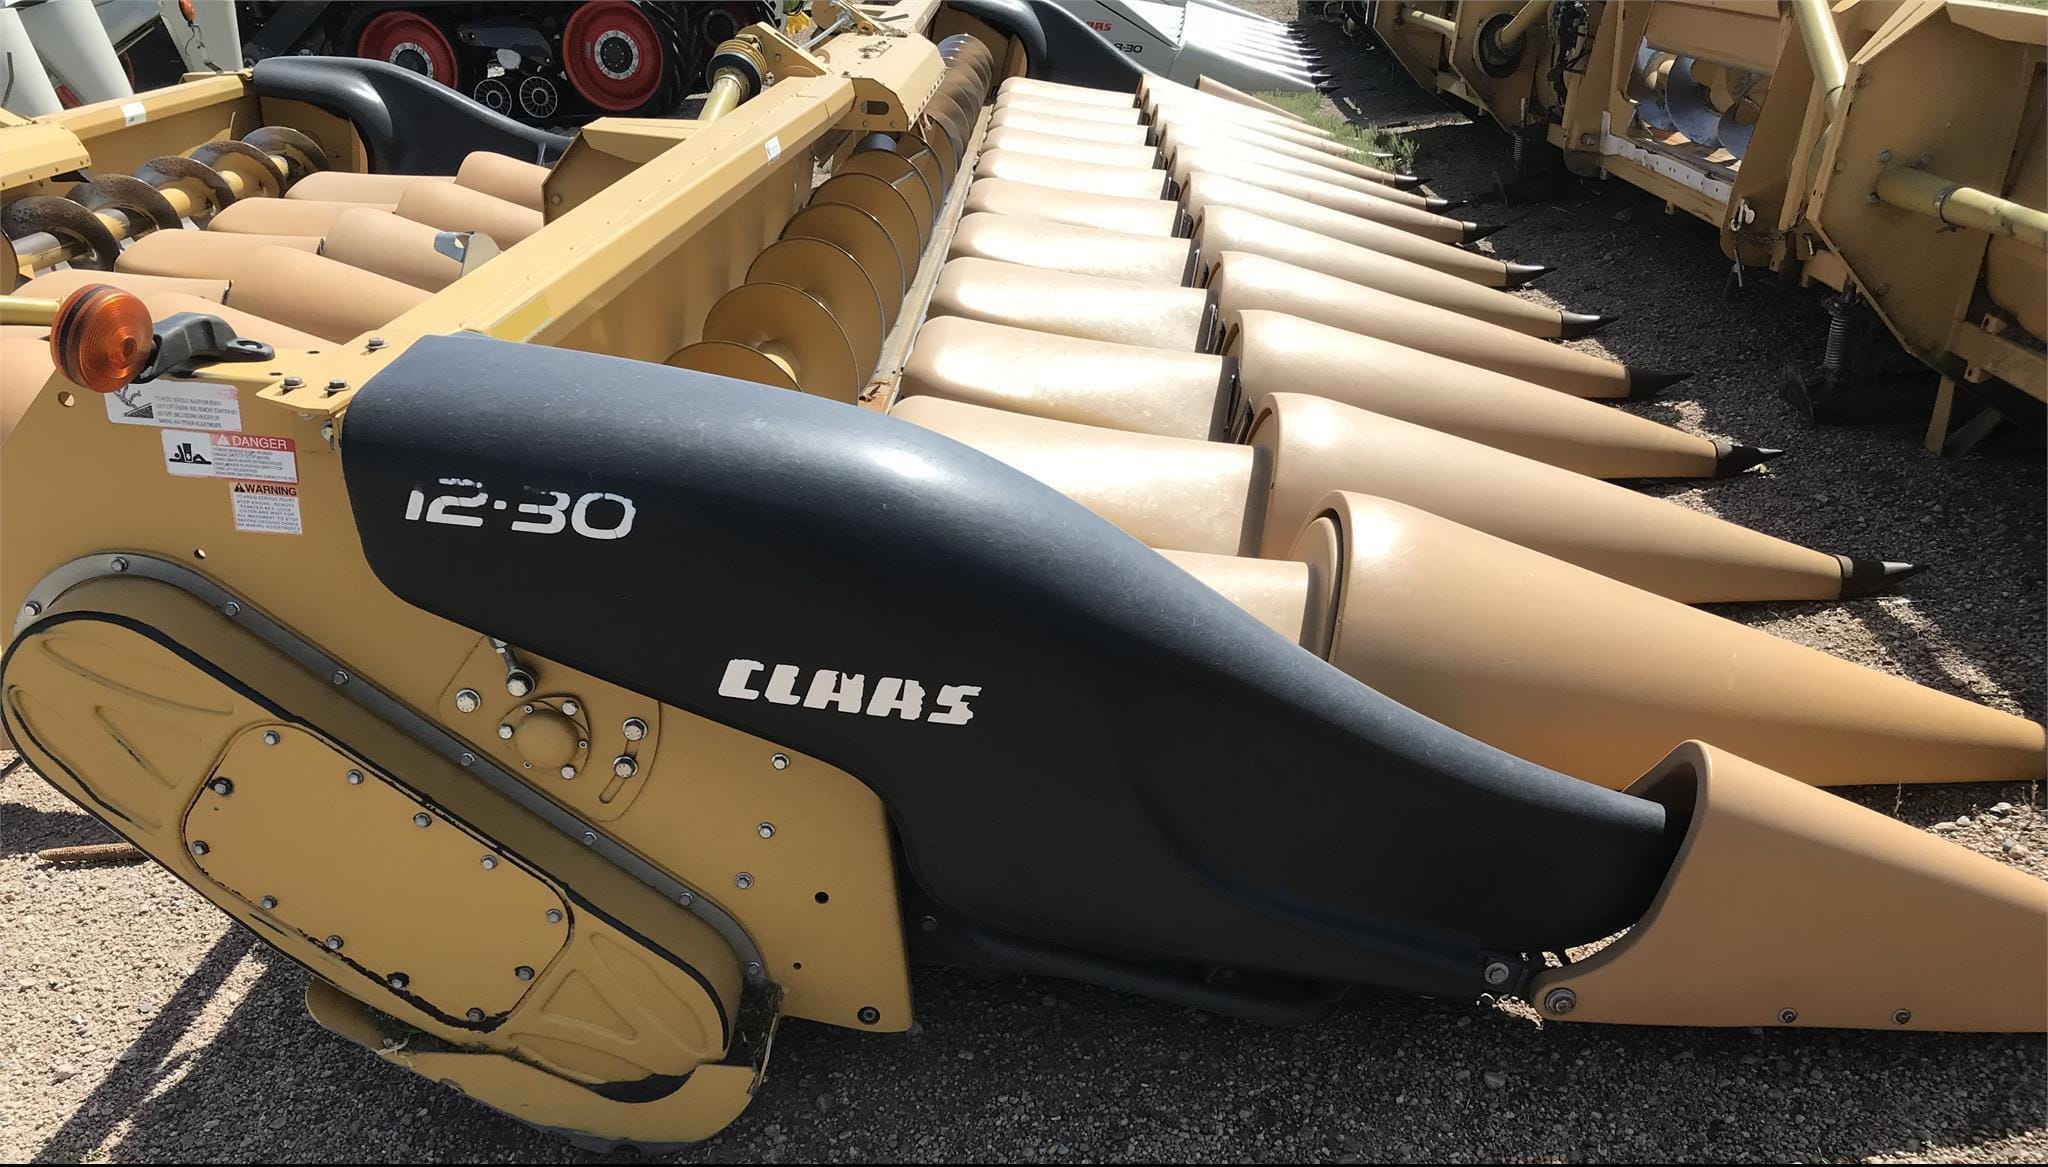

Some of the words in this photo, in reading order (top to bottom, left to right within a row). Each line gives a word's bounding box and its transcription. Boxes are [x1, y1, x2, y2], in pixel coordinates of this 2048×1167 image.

[231, 435, 288, 450] DANGER
[245, 484, 297, 496] WARNING
[718, 658, 983, 726] CLAAS
